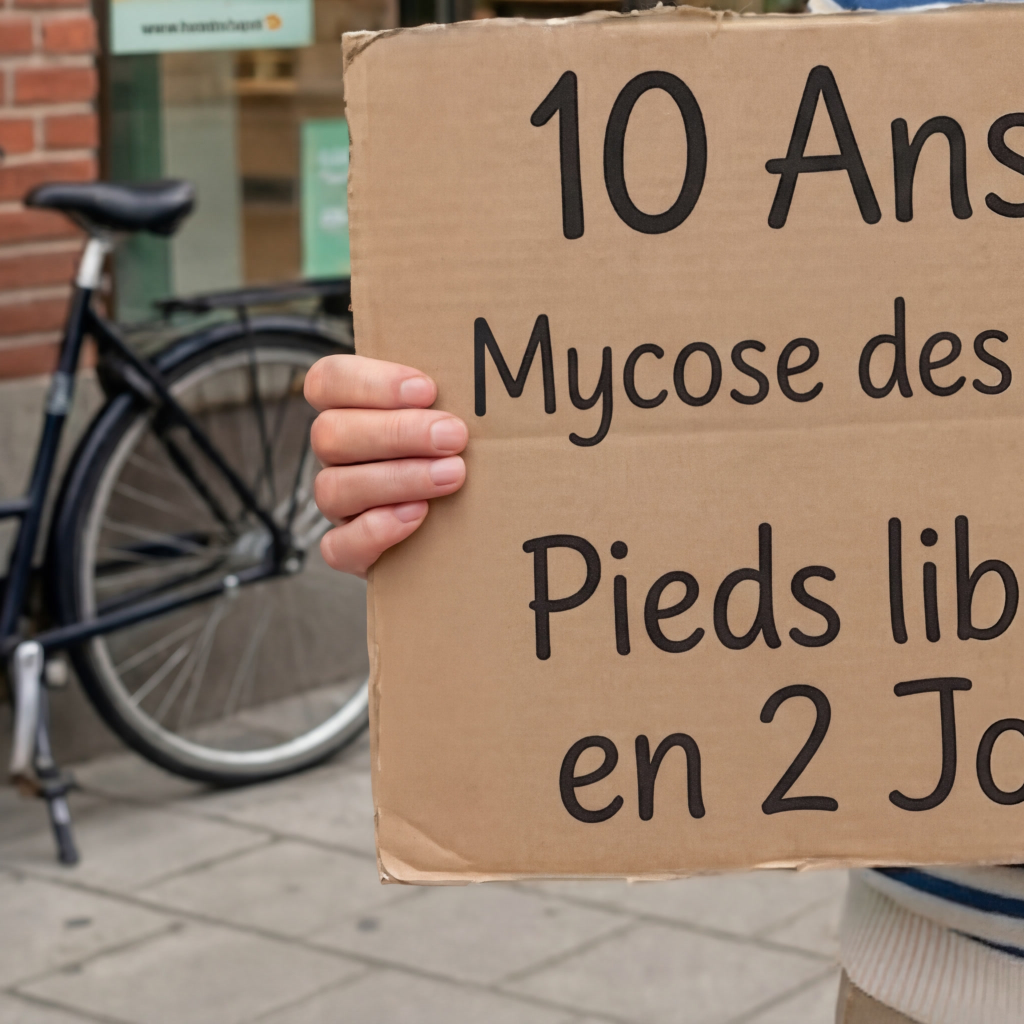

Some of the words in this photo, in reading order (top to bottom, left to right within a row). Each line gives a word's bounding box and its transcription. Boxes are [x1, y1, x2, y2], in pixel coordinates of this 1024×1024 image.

[530, 70, 709, 240] 10
[473, 313, 823, 447] Mycose
[857, 296, 1013, 400] des
[522, 523, 842, 662] Pieds
[558, 728, 707, 824] en
[758, 684, 839, 815] 2
